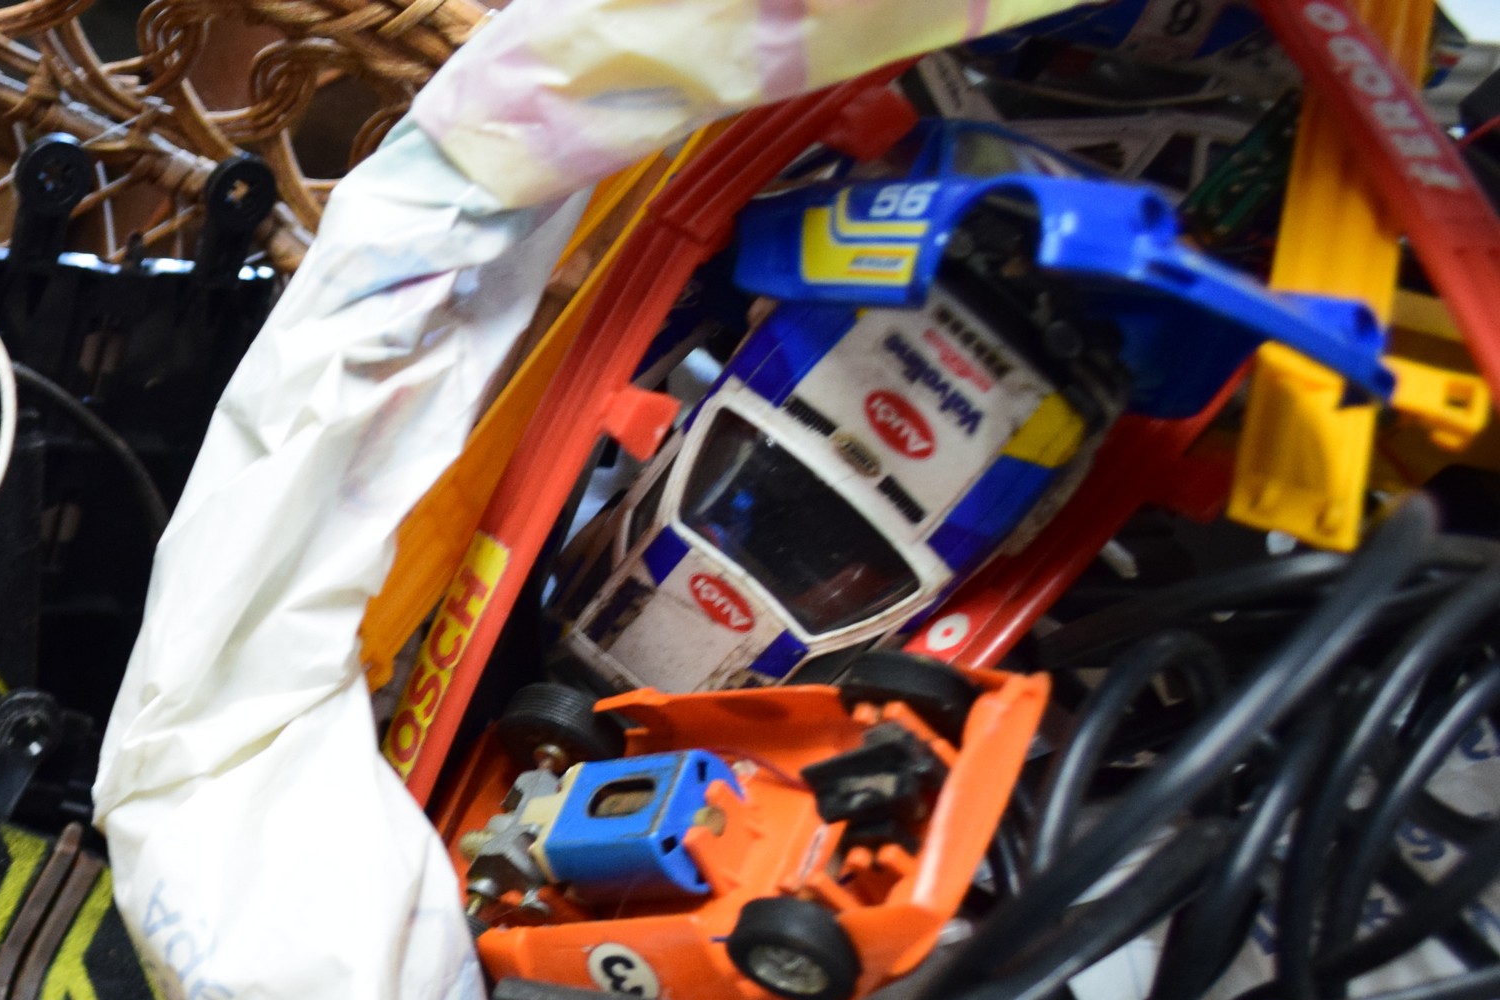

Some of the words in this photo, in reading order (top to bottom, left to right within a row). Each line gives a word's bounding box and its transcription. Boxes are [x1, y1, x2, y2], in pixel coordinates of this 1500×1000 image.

[1303, 2, 1463, 190] FERODO
[883, 329, 985, 437] Valvoline
[389, 564, 490, 765] OSCH
[601, 955, 644, 998] 3
